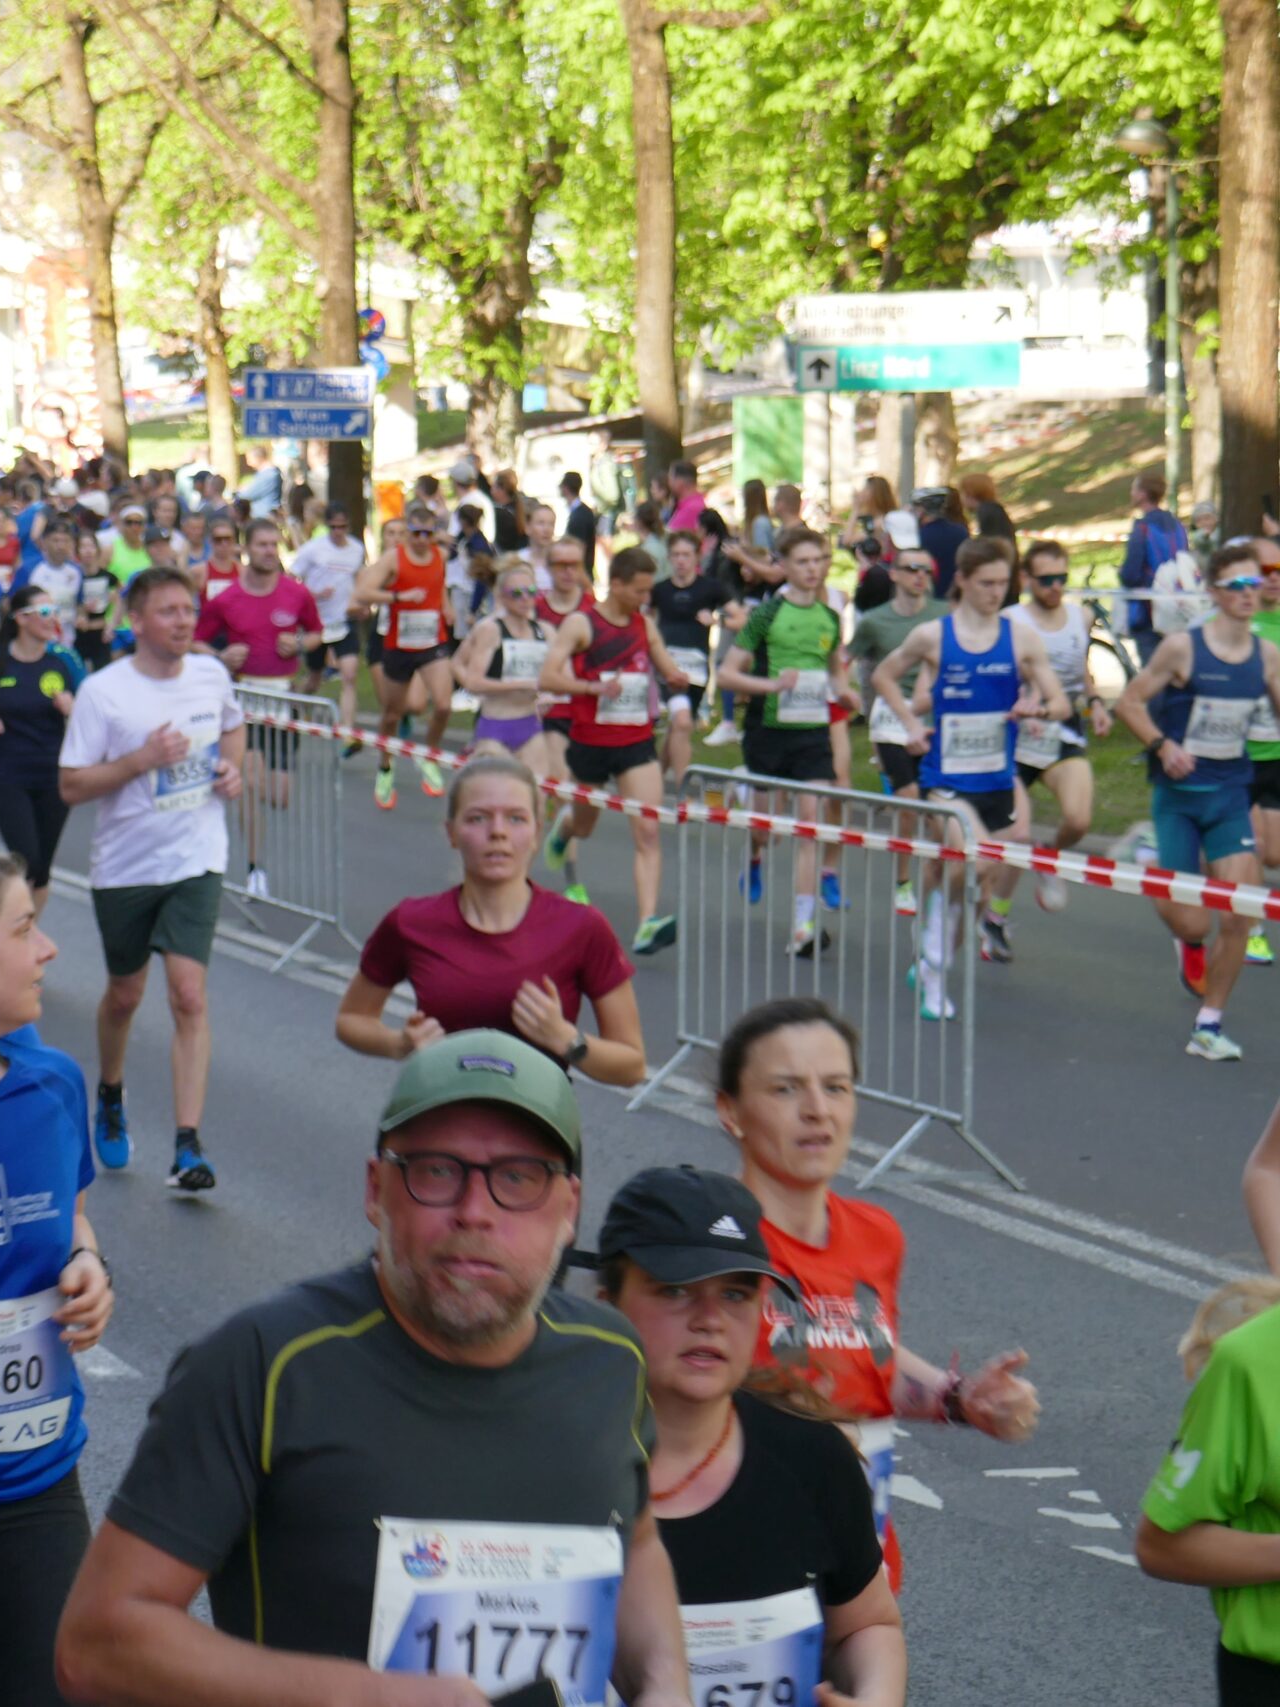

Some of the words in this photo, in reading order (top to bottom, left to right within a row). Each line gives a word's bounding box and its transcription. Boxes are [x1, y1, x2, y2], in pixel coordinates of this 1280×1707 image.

[840, 358, 880, 379] Linz
[289, 408, 331, 421] Wien
[277, 421, 340, 437] Salzburg
[13, 1415, 59, 1443] AG
[415, 1619, 590, 1682] 11777
